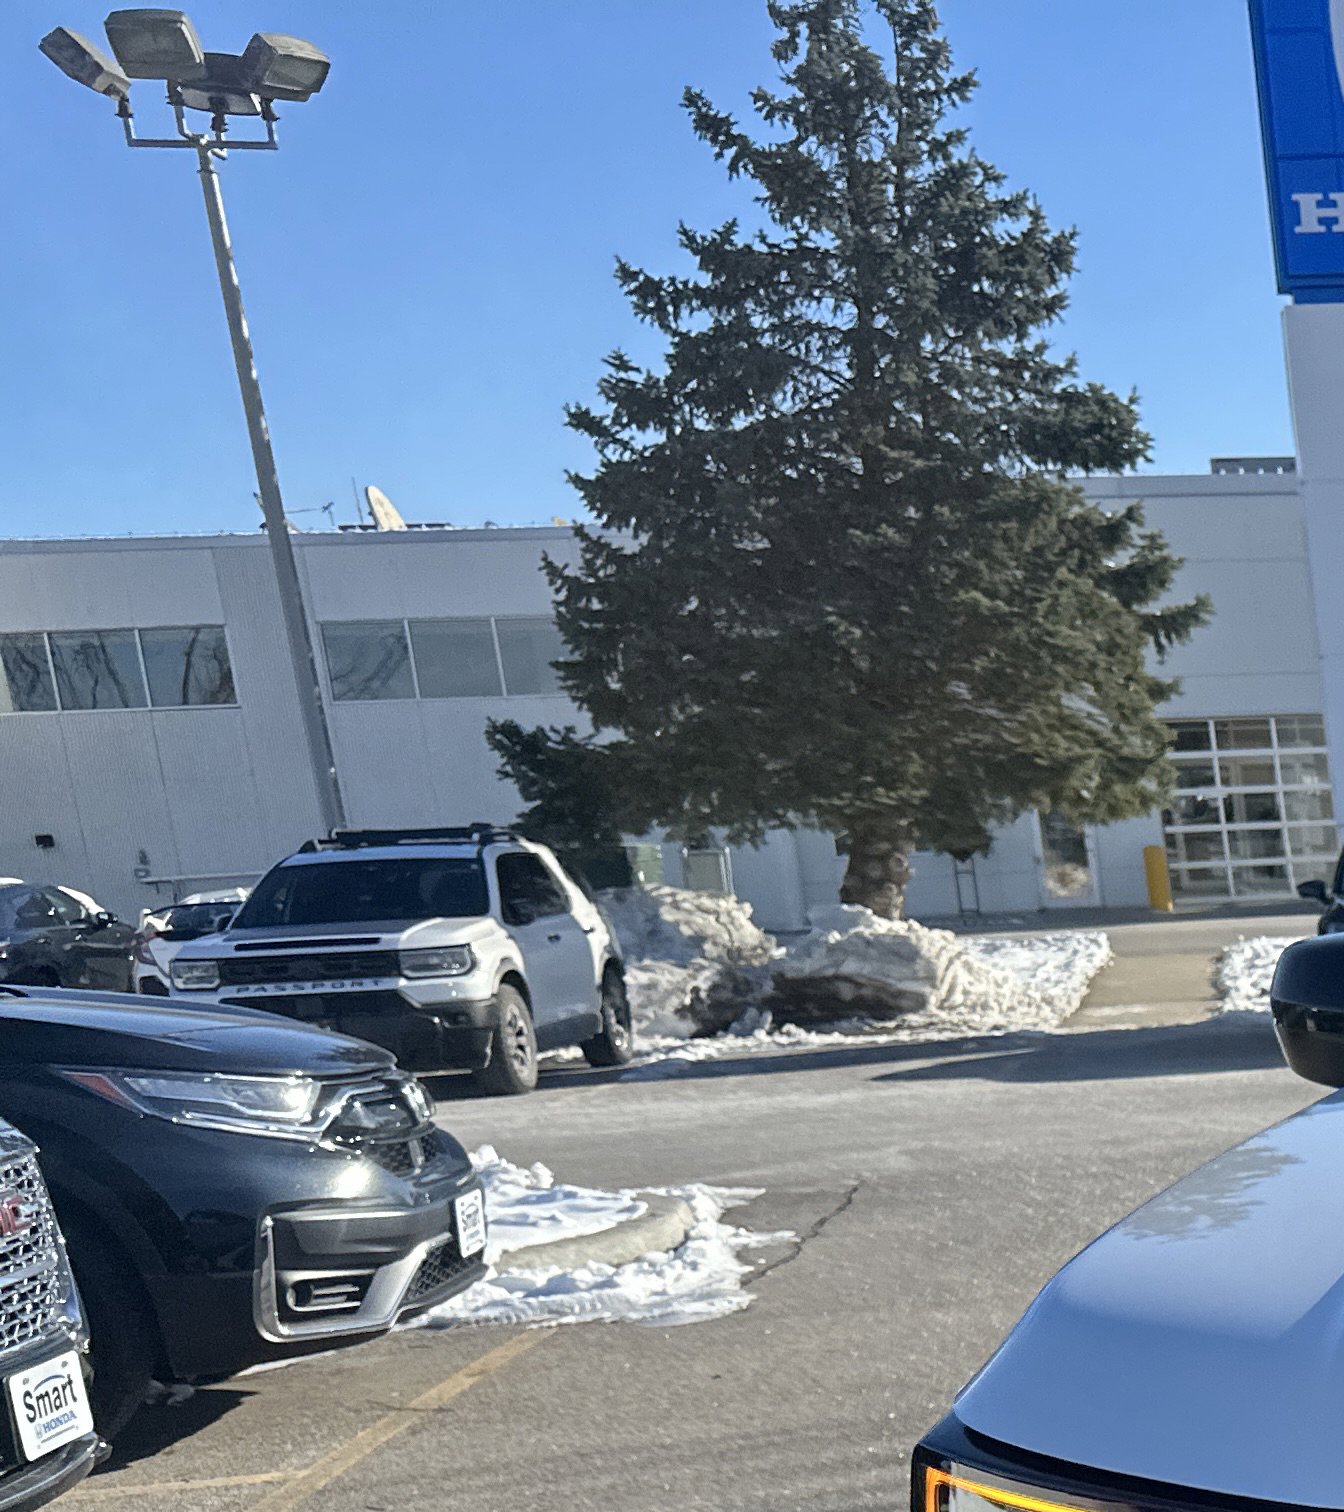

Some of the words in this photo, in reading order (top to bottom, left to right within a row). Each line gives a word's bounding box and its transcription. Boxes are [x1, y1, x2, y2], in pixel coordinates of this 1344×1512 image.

[236, 979, 384, 994] PASSPORT
[23, 1373, 78, 1424] Smart
[42, 1410, 77, 1434] HONDA
